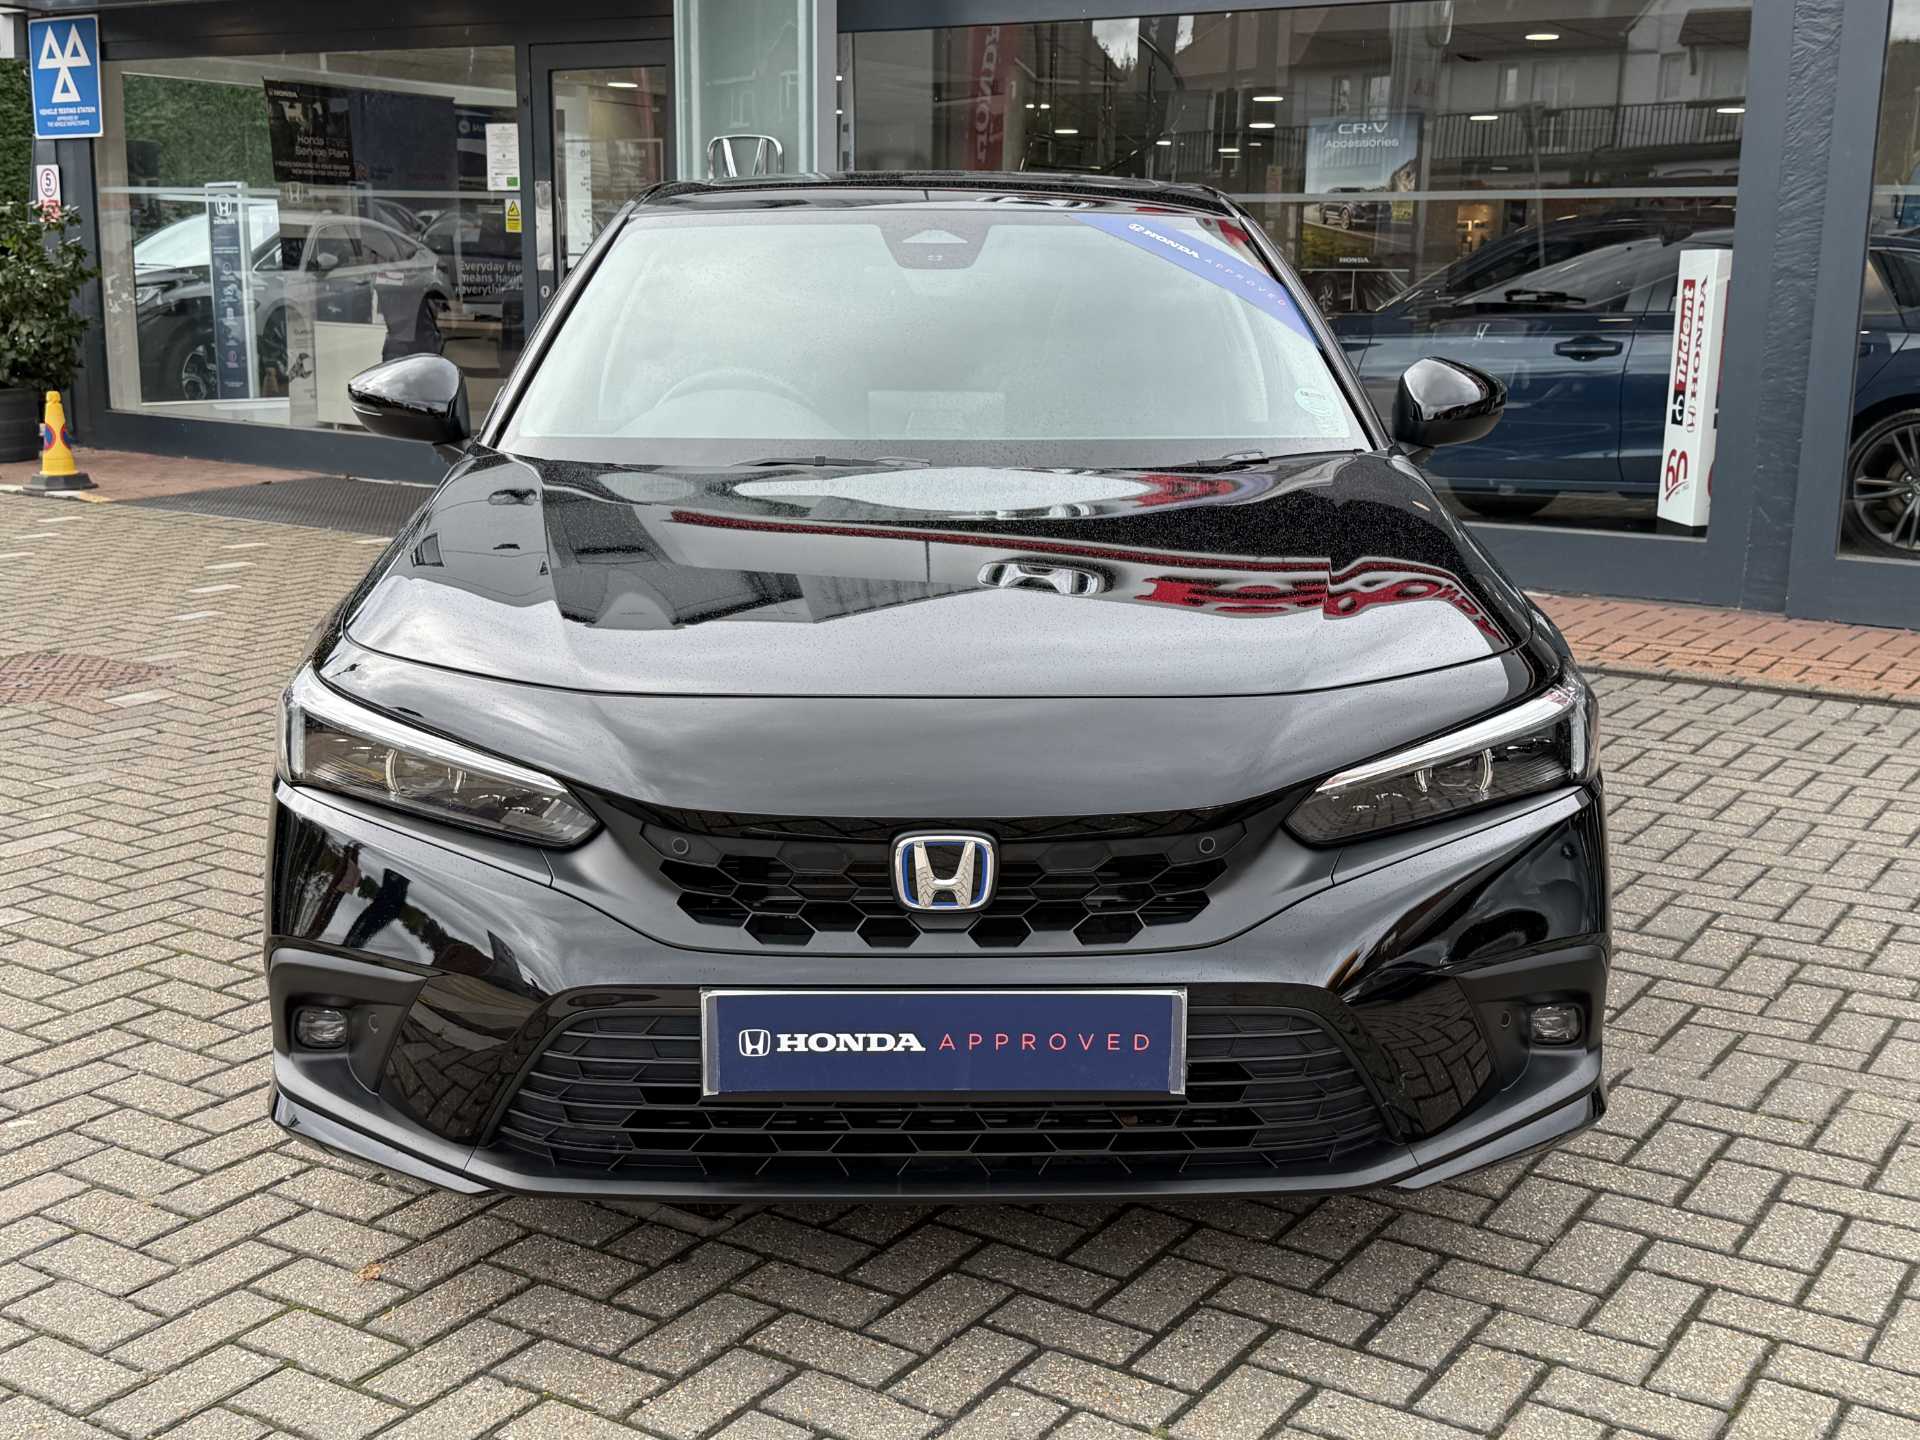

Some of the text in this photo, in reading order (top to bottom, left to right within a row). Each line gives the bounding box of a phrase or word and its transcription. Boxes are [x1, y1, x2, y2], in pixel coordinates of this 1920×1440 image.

[297, 136, 324, 146] Honda
[1326, 138, 1399, 149] Accessories
[296, 146, 349, 158] Service Plan
[45, 172, 52, 187] 5
[1143, 229, 1200, 259] HONDA
[1676, 285, 1695, 385] Trident
[1690, 274, 1708, 400] HONDA
[776, 1032, 1151, 1052] HONDA APPROVED
